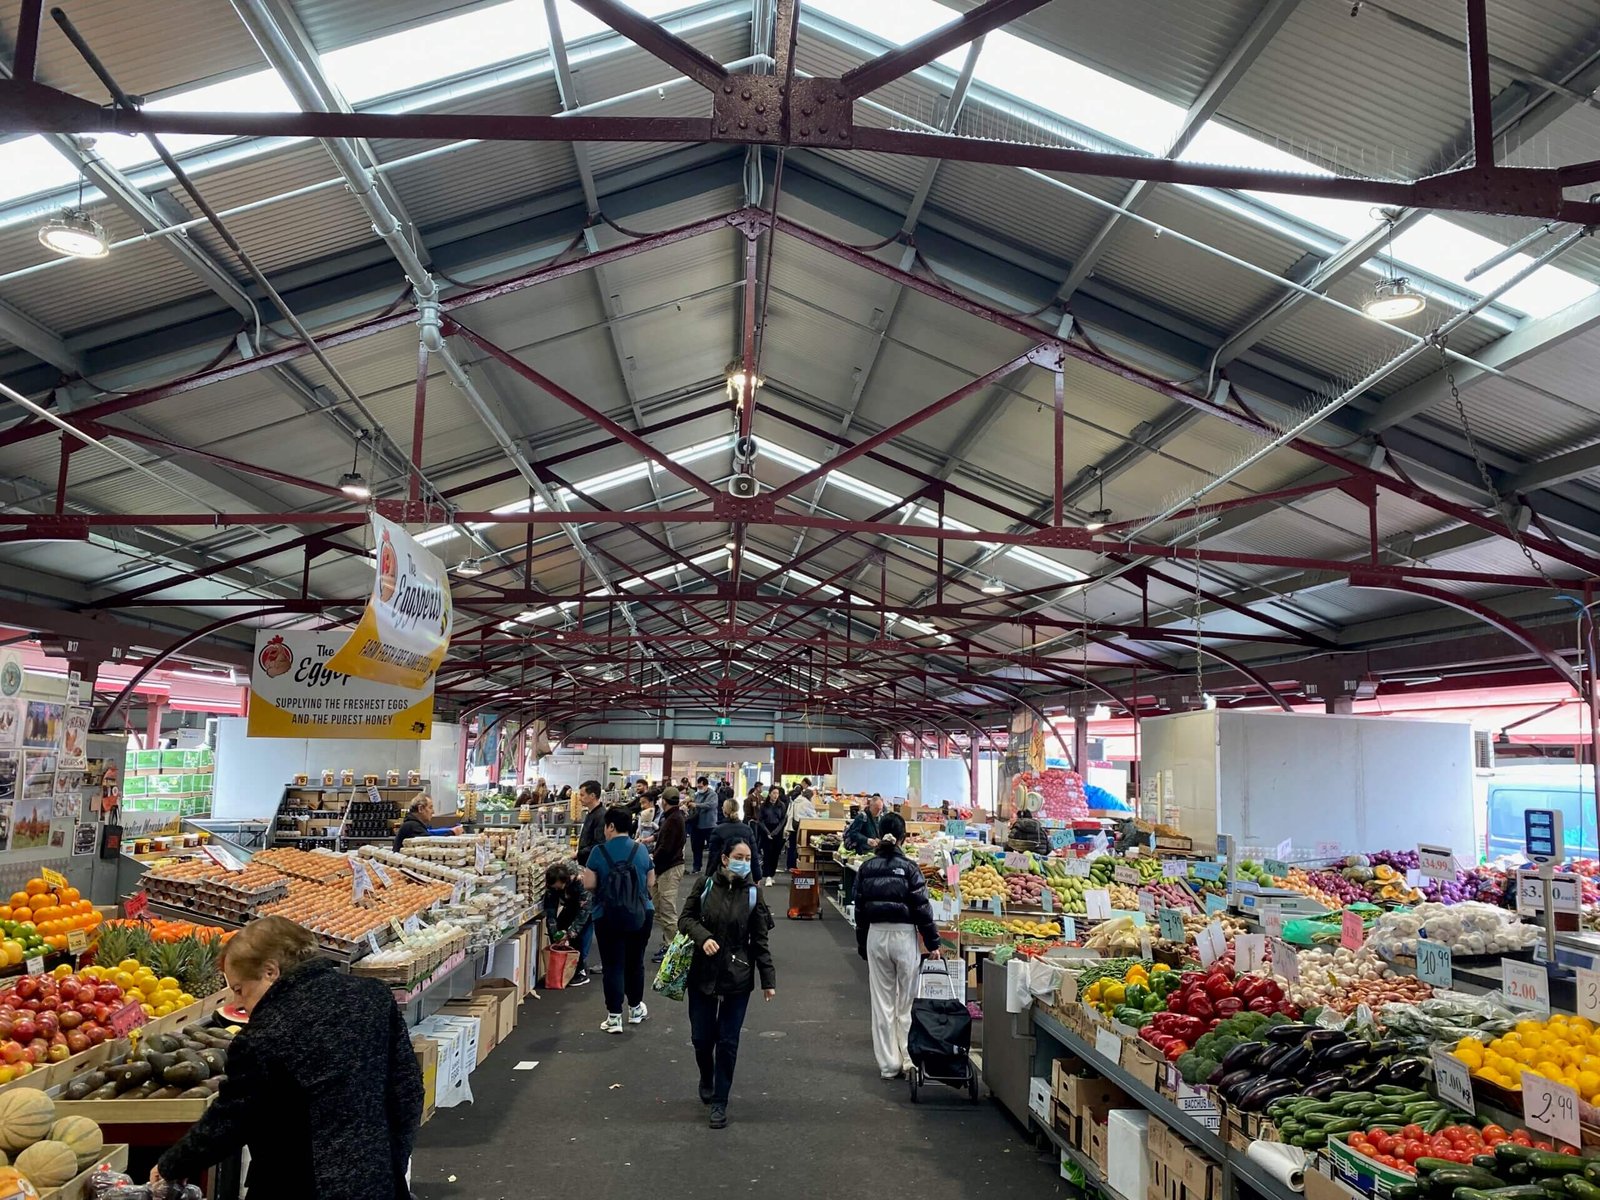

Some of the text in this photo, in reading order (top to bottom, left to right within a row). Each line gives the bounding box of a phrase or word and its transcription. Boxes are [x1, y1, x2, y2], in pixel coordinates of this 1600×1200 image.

[407, 553, 417, 577] The
[391, 574, 442, 631] Eggsperts
[67, 641, 79, 652] B17
[317, 645, 335, 657] The
[358, 639, 381, 659] FARM
[375, 643, 399, 664] FRESH
[275, 697, 409, 710] SUPPLYING THE FRESHEST EGGS
[291, 713, 393, 726] AND THE PUREST HONEY
[712, 731, 721, 741] B
[1522, 885, 1561, 900] $3.0
[1508, 980, 1536, 1001] $2.00
[1184, 1098, 1207, 1109] BACCHUS
[1531, 1092, 1573, 1123] 2.99
